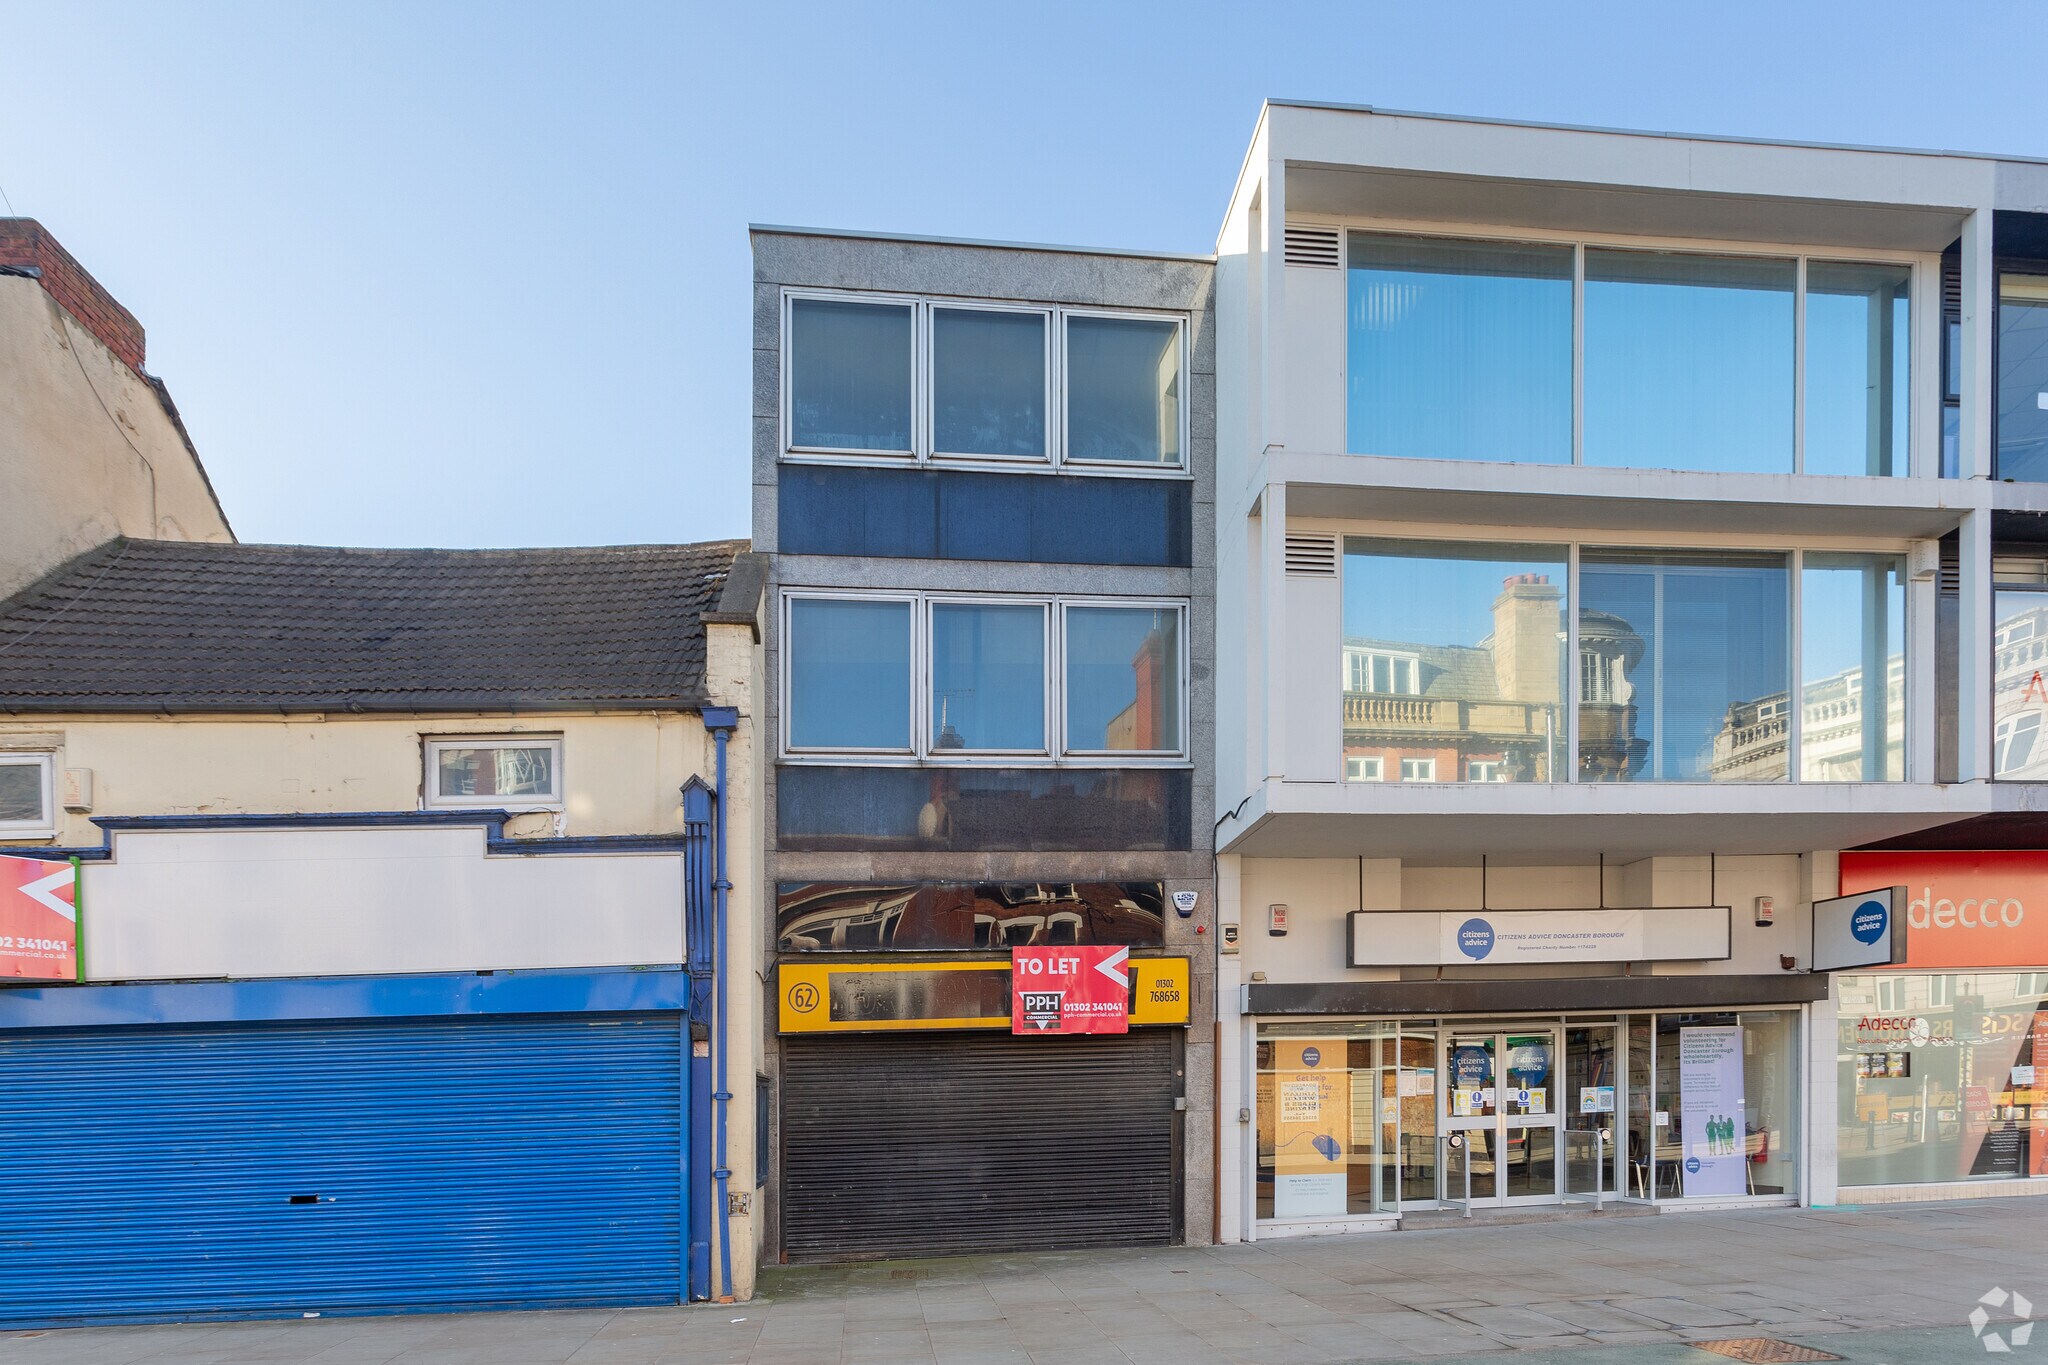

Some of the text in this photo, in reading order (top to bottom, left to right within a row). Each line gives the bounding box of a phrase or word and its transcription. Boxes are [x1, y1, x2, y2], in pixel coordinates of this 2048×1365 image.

[1908, 887, 2024, 929] decco
[1856, 913, 1883, 924] citizens
[1857, 921, 1881, 932] advice
[1462, 930, 1490, 938] citizens
[17, 937, 67, 951] 341041
[1017, 957, 1080, 975] TO LET
[1155, 979, 1174, 989] 01302
[795, 988, 813, 1008] 62
[1150, 991, 1180, 1002] 768658
[1026, 996, 1058, 1011] PPH
[1064, 1002, 1122, 1011] 01302 341041
[1064, 1011, 1122, 1019] pph-commercial.co.uk
[1457, 1057, 1485, 1065] citizens
[1459, 1065, 1483, 1073] advice
